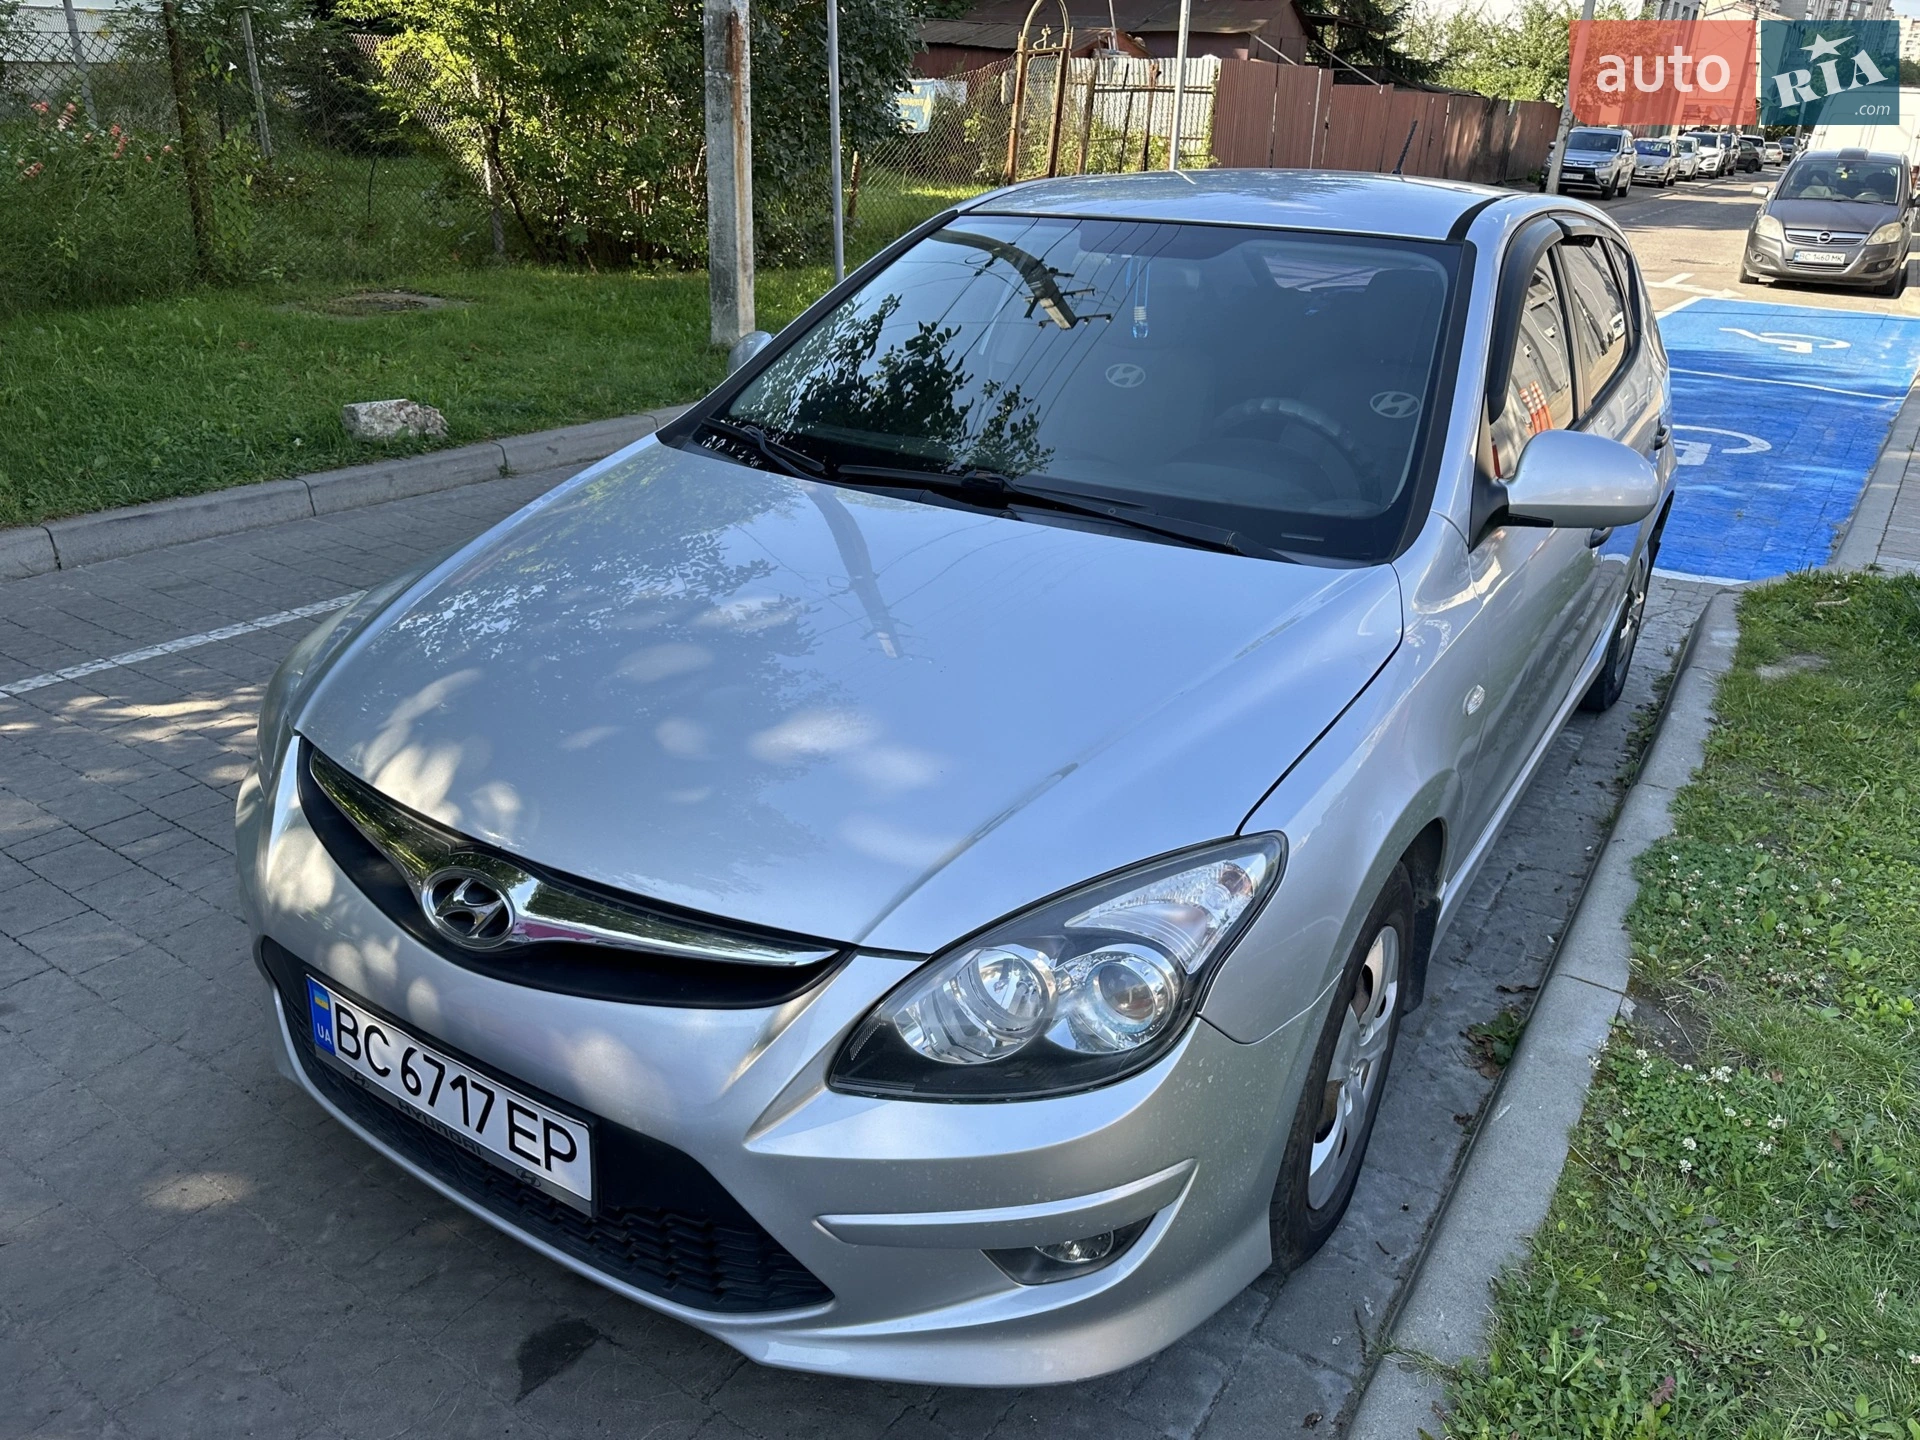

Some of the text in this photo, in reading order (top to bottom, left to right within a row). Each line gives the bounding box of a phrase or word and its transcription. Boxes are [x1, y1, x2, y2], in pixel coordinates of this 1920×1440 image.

[317, 1022, 333, 1044] UA
[335, 1002, 577, 1172] BC 6717 EP
[397, 1098, 483, 1156] HYUNDAI
